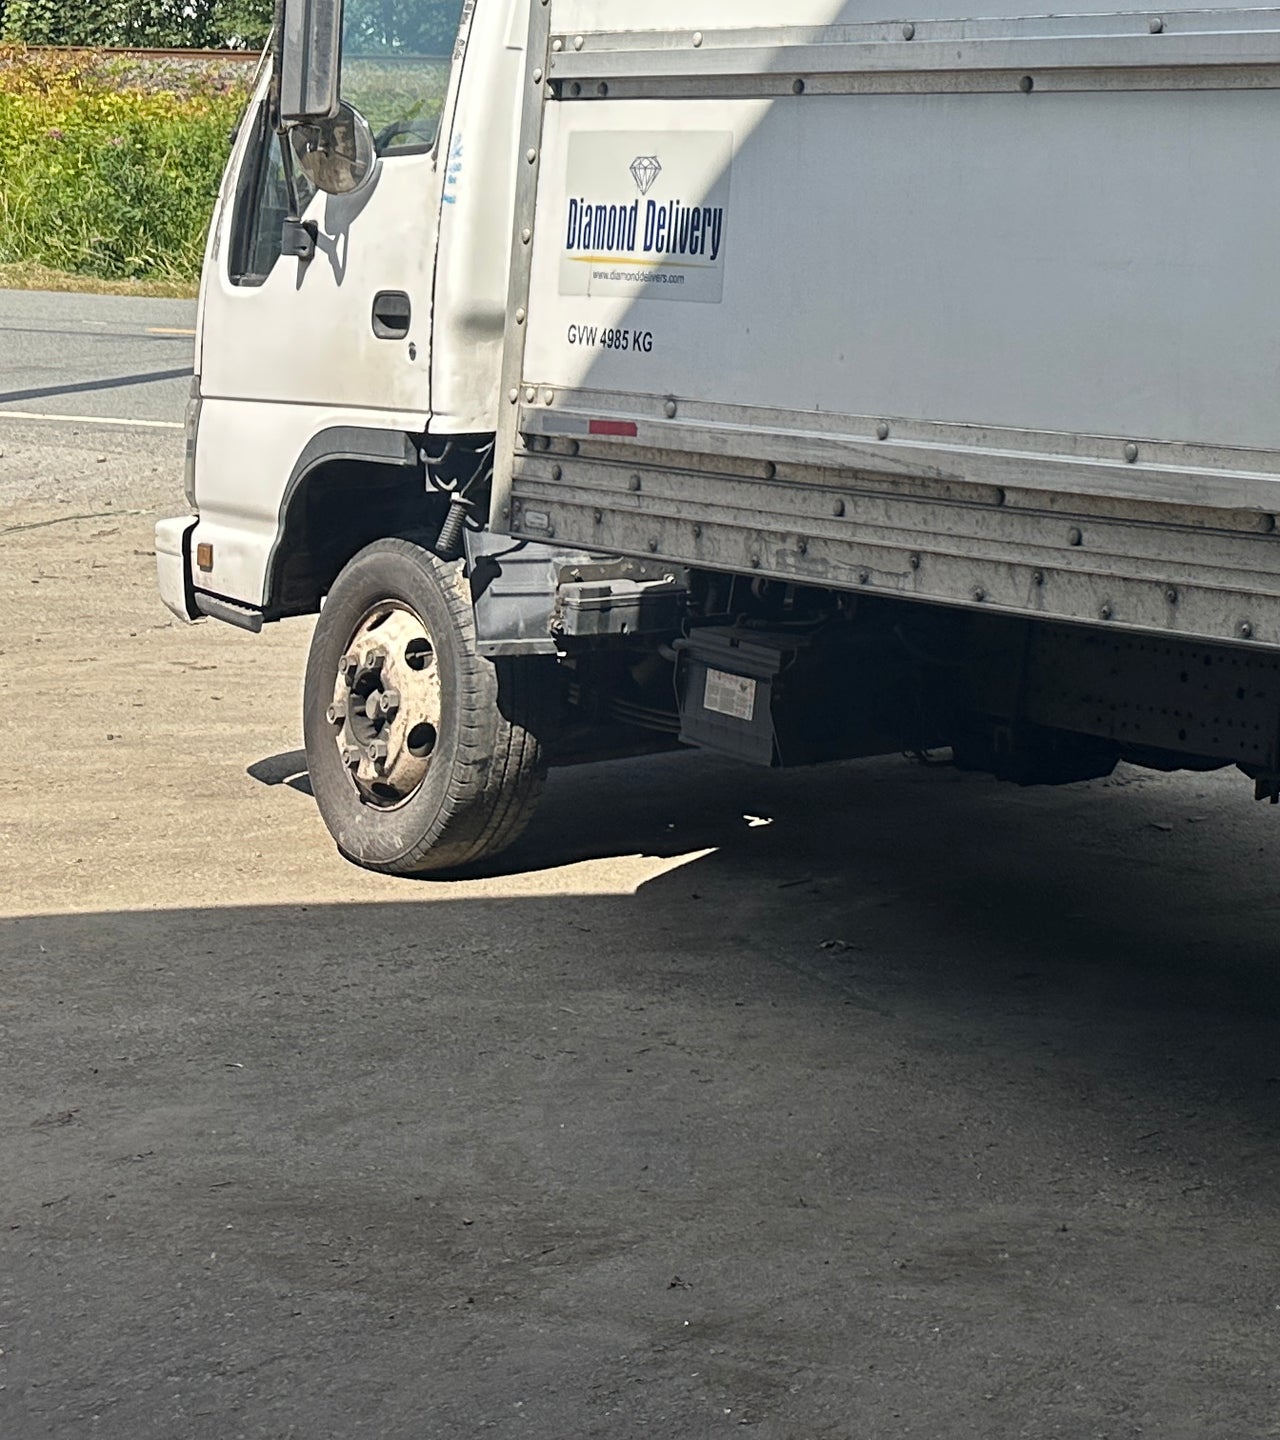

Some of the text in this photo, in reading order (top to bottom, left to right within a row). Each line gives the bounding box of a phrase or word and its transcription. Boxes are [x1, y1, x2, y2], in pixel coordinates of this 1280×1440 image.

[566, 198, 723, 261] Diamond Delivery
[592, 269, 685, 285] www.diamonddelivers.com
[567, 324, 653, 353] GVW 4985 KG
